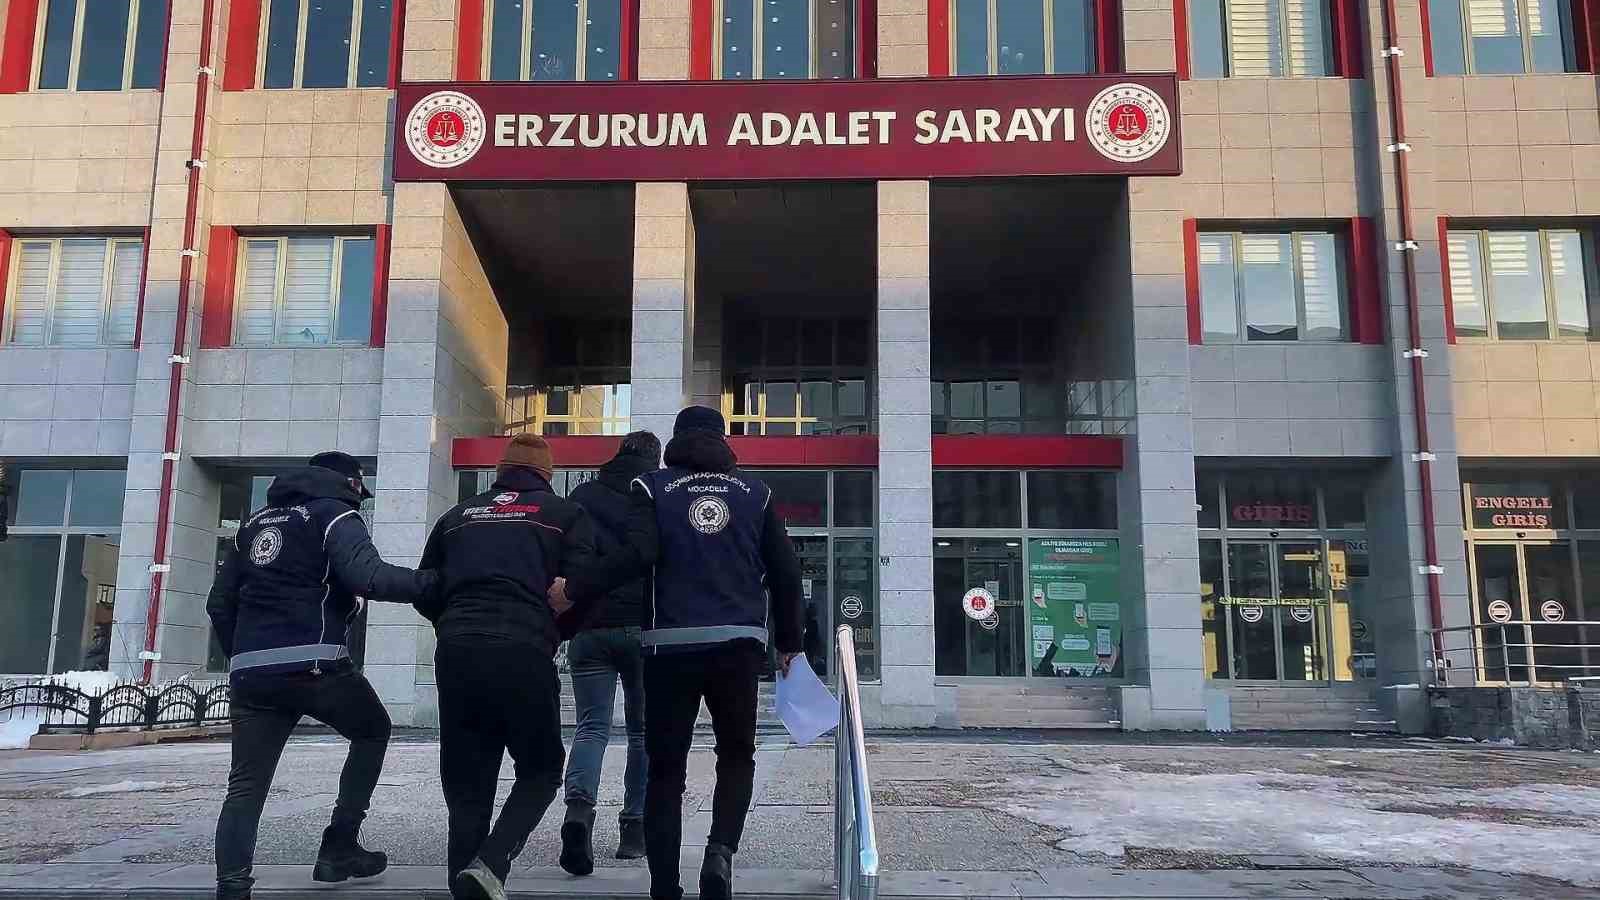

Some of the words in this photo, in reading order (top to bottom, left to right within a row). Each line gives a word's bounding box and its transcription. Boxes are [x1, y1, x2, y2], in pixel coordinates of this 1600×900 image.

[494, 113, 708, 147] ERZURUM
[727, 111, 897, 146] ADALET
[914, 108, 1075, 144] SARAYI
